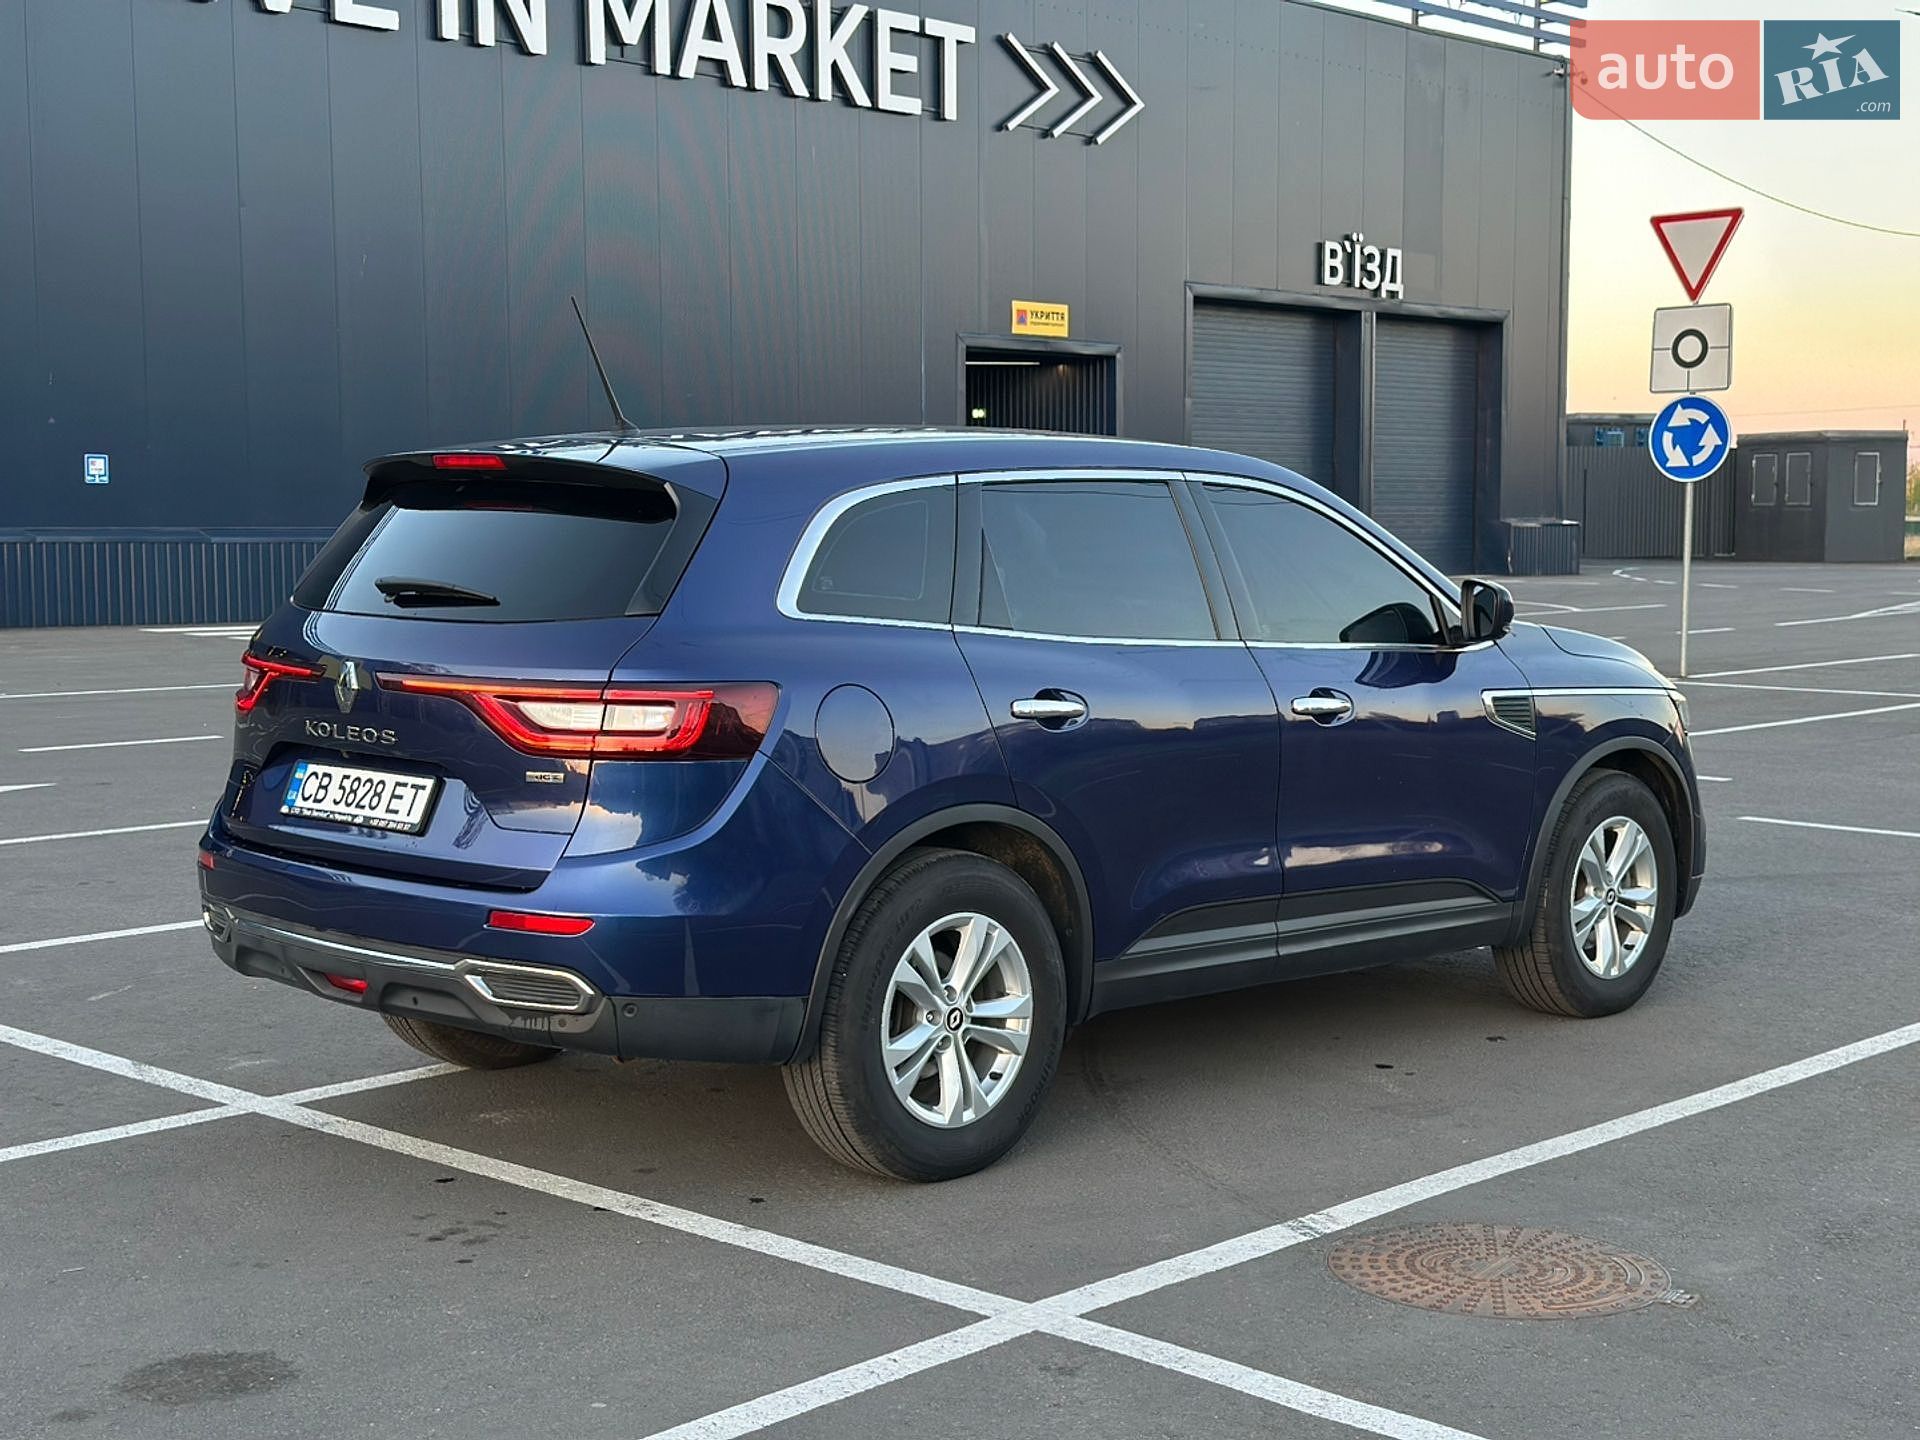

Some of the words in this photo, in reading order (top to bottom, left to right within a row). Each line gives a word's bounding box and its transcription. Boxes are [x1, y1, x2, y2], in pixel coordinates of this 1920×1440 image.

[585, 0, 976, 121] MARKET
[304, 719, 399, 745] KOLEOS
[301, 771, 333, 804] CB
[332, 774, 387, 811] 5828
[385, 781, 428, 817] ET
